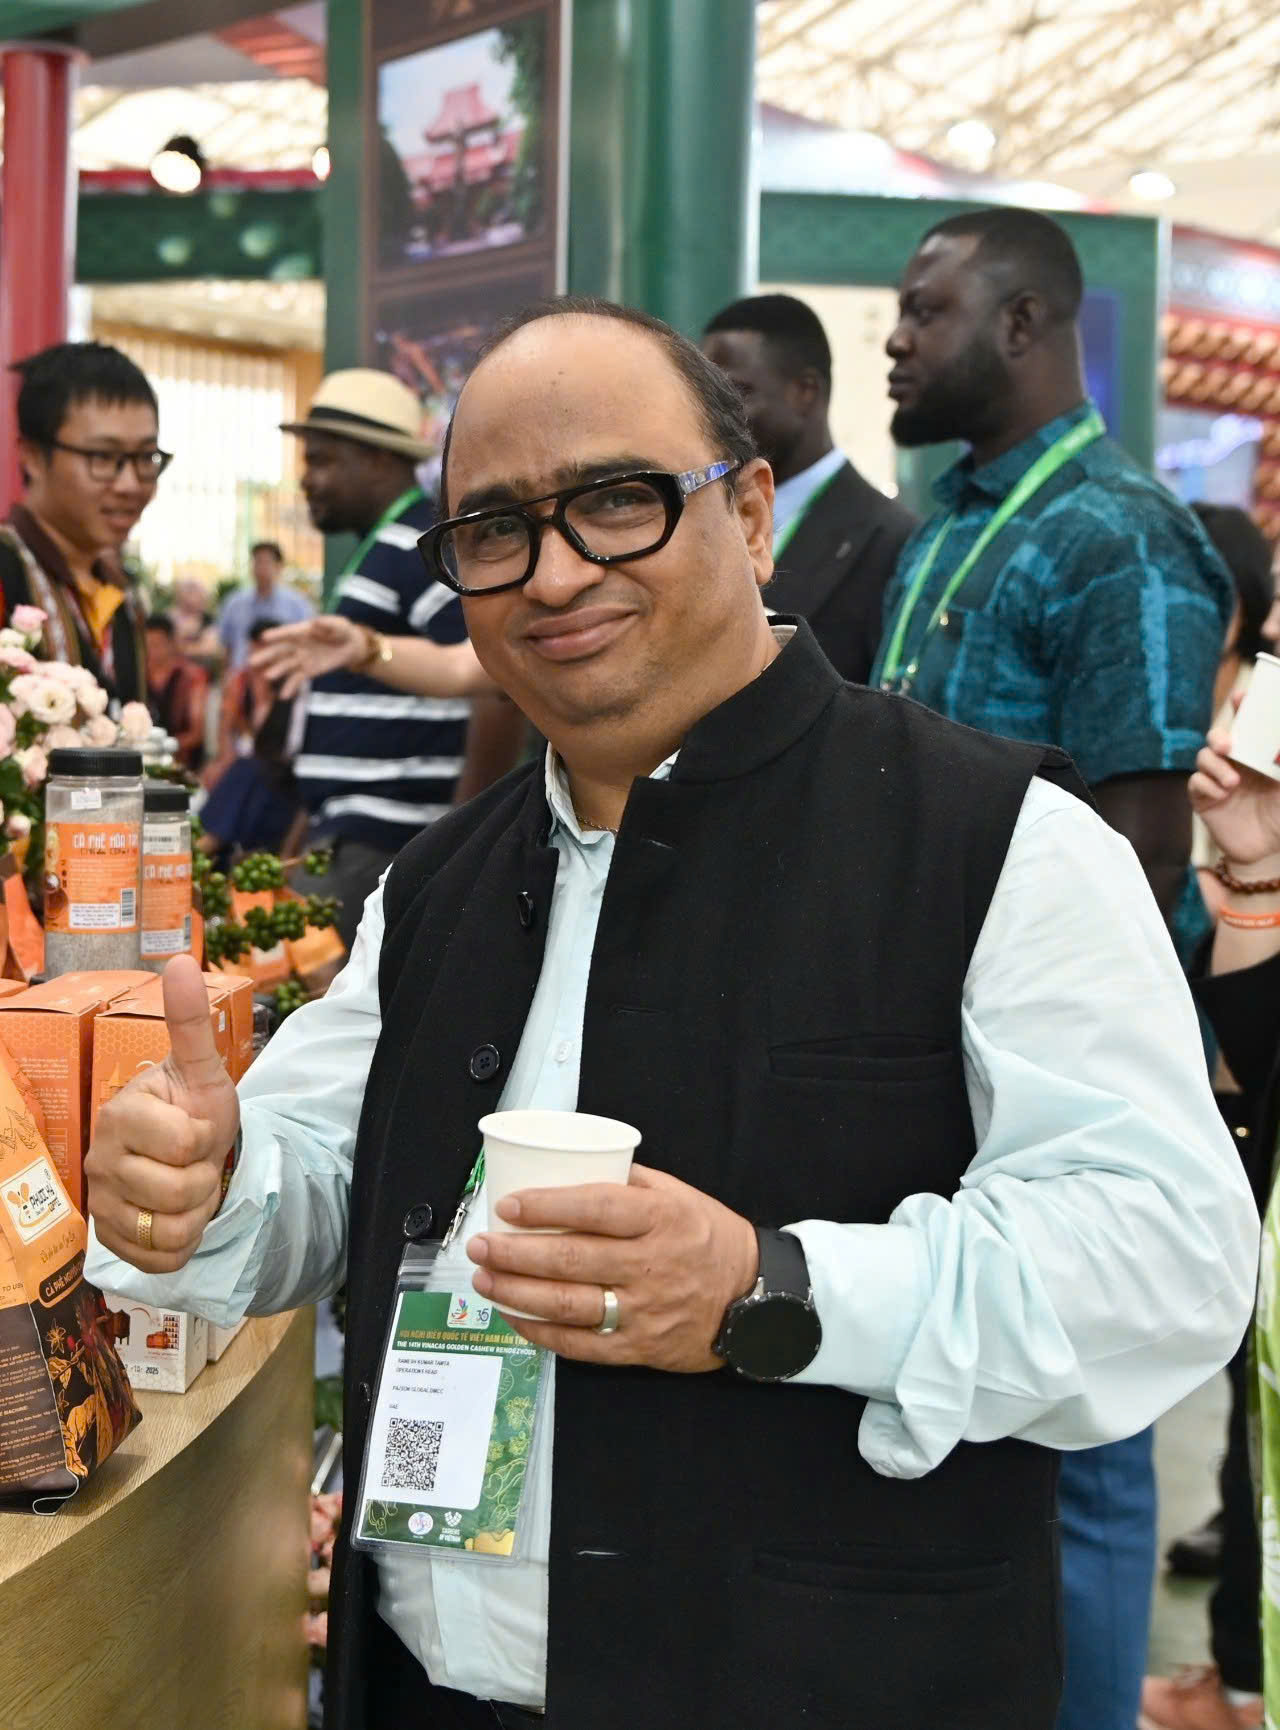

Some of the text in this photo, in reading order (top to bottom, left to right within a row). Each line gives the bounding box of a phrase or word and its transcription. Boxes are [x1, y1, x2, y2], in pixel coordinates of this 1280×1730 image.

[421, 1341, 446, 1350] VINACAS
[446, 1342, 469, 1350] GOLDEN
[470, 1344, 495, 1353] CASHEW
